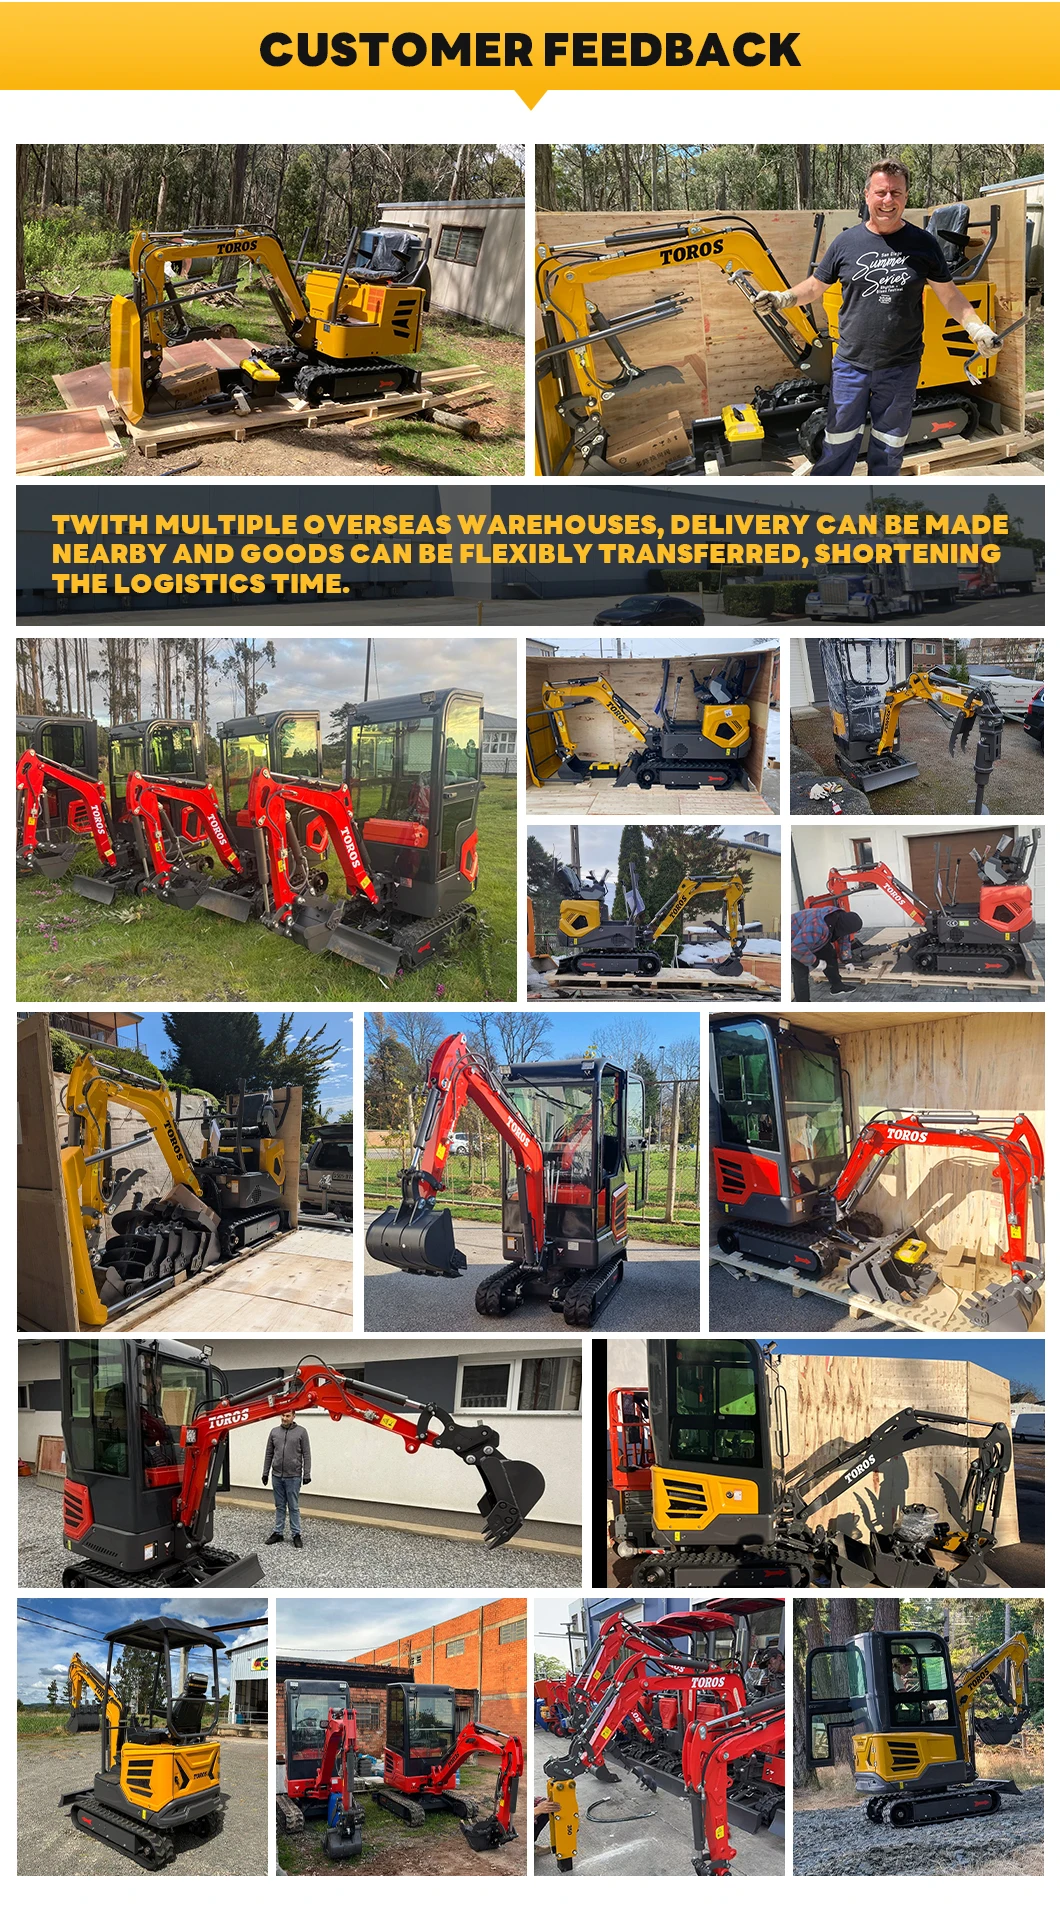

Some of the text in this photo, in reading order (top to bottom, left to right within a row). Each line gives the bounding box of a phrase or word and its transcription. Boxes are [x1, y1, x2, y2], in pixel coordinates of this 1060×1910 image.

[216, 240, 258, 256] TOROS
[659, 239, 725, 266] TOROS
[851, 251, 910, 281] Summer
[861, 267, 911, 297] Series
[606, 701, 630, 725] TOROS
[90, 804, 106, 836] TOROS
[207, 813, 227, 847] TOROS
[340, 826, 361, 870] TOROS
[669, 895, 688, 920] TOROS
[883, 882, 906, 906] TOROS
[163, 1119, 184, 1163] TOROS
[506, 1116, 531, 1148] TOROS
[886, 1128, 928, 1143] TOROS
[208, 1407, 250, 1430] TOROS
[844, 1455, 877, 1485] TOROS
[691, 1676, 726, 1689] TOROS
[967, 1667, 990, 1692] TOROS
